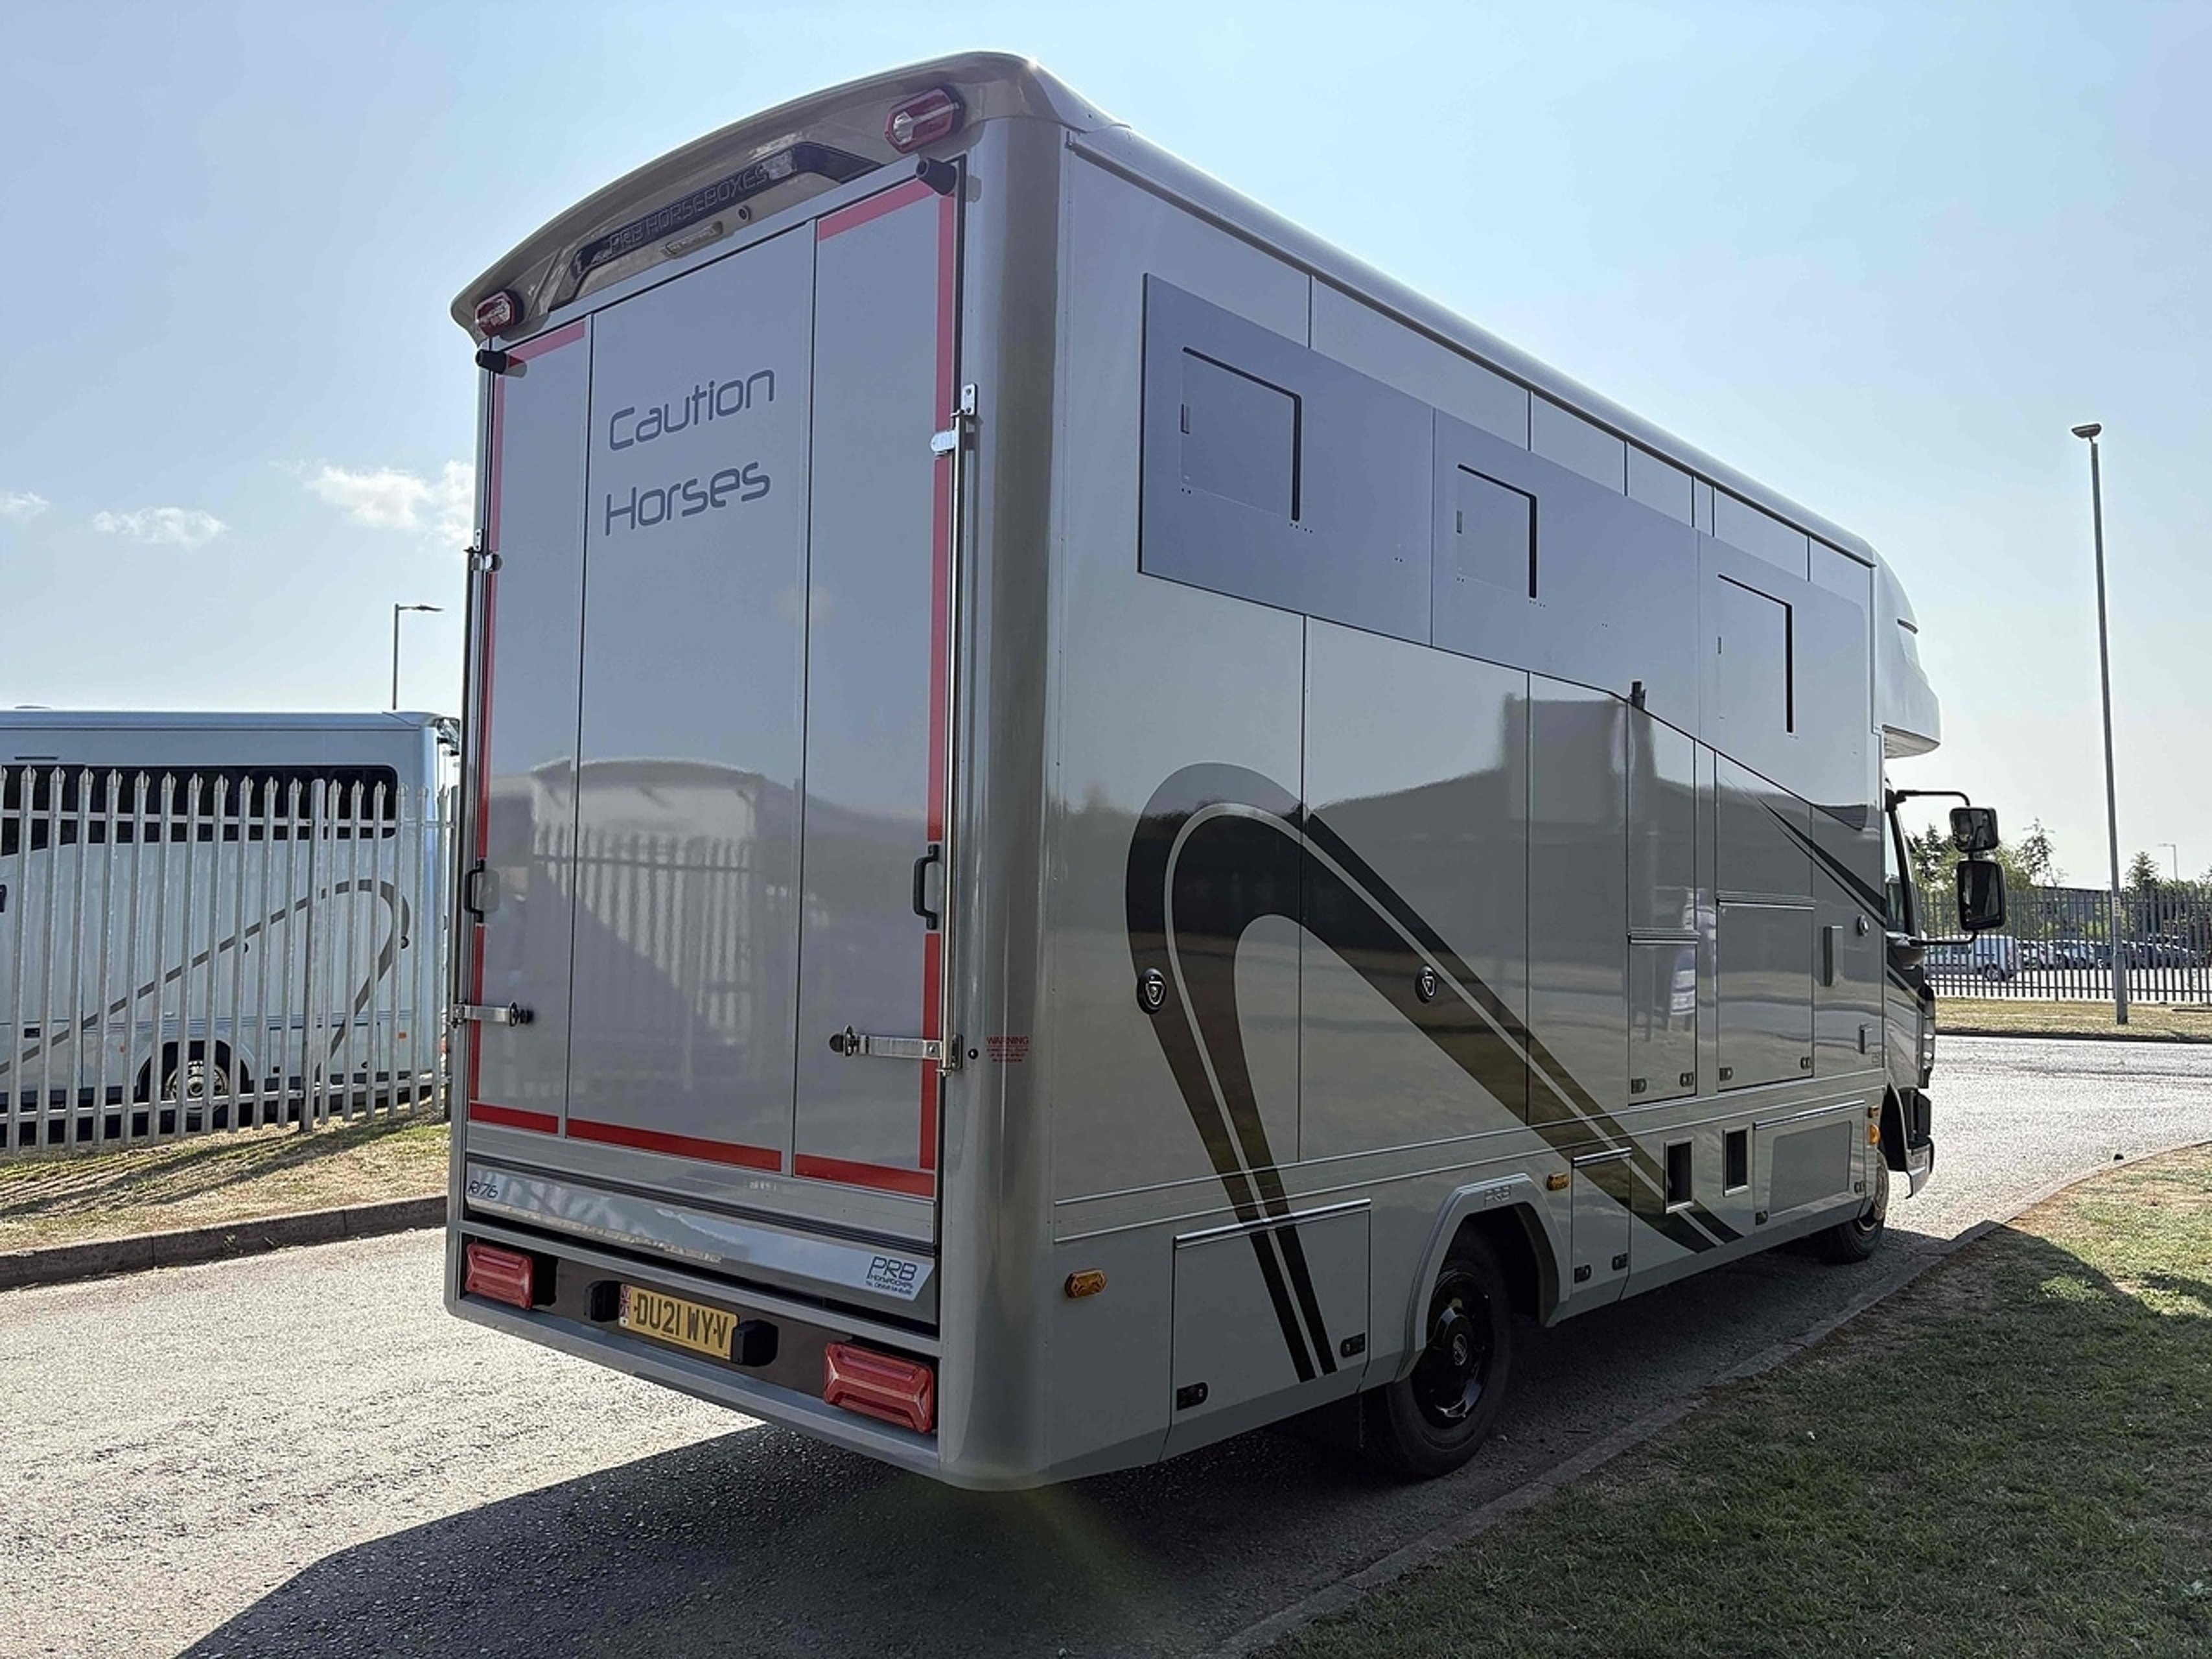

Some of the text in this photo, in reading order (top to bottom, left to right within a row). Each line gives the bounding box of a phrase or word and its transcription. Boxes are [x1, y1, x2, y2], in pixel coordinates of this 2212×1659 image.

[608, 229, 644, 257] PRB
[609, 369, 774, 450] Caution
[606, 461, 770, 536] Horses
[867, 1256, 917, 1281] PRB
[636, 1294, 728, 1349] DU21 WYV
